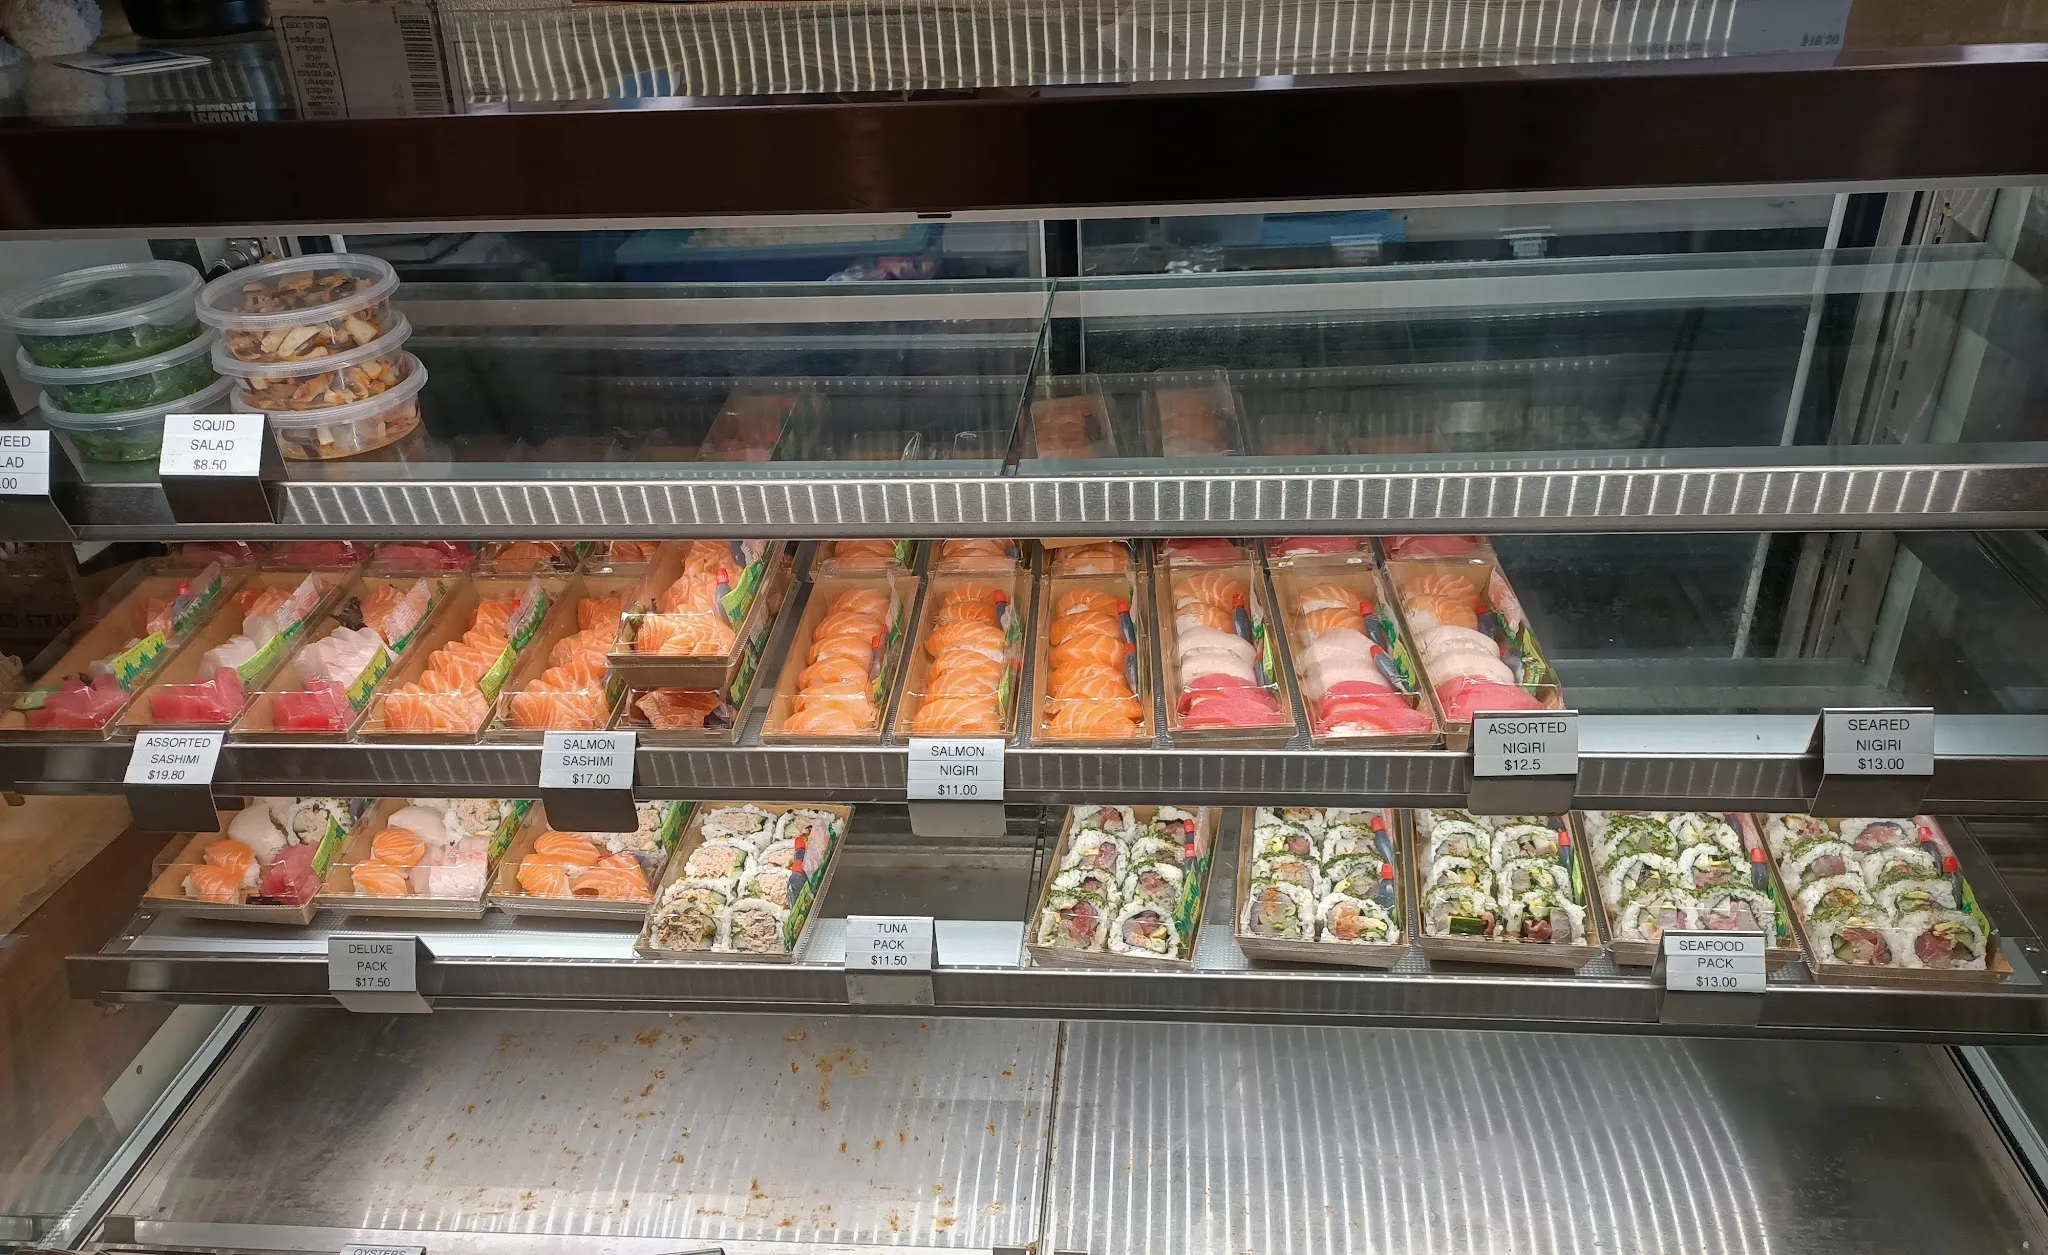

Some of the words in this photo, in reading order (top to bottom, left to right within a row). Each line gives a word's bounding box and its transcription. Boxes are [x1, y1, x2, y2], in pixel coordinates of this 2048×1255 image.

[193, 420, 235, 431] SQUID
[0, 436, 31, 447] EED
[190, 439, 235, 451] SALAD
[193, 459, 227, 470] $8.50
[1488, 722, 1567, 734] ASSORTED
[1848, 719, 1910, 731] SEARED
[146, 737, 211, 748] ASSORTED
[563, 738, 616, 750] SALMON
[1503, 742, 1545, 753] NIGIRI
[1856, 739, 1901, 751] NIGIRI
[931, 745, 985, 757] SALMON
[150, 754, 200, 764] SASHIMI
[562, 755, 613, 766] SASHIMI
[1858, 757, 1905, 770] $13.00
[940, 765, 978, 776] NIGIRI
[1504, 759, 1541, 771] $12.5
[147, 769, 185, 780] $19.80
[572, 773, 610, 784] $17.00
[938, 784, 978, 796] $11.00
[877, 923, 908, 933] TUNA
[348, 944, 393, 954] DELUXE
[873, 940, 904, 950] PACK
[1679, 940, 1744, 952] SEAFOOD
[357, 961, 388, 971] PACK
[871, 955, 907, 966] $11.50
[1697, 957, 1734, 969] PACK
[355, 977, 391, 987] $17.50
[1696, 976, 1738, 988] $13.00
